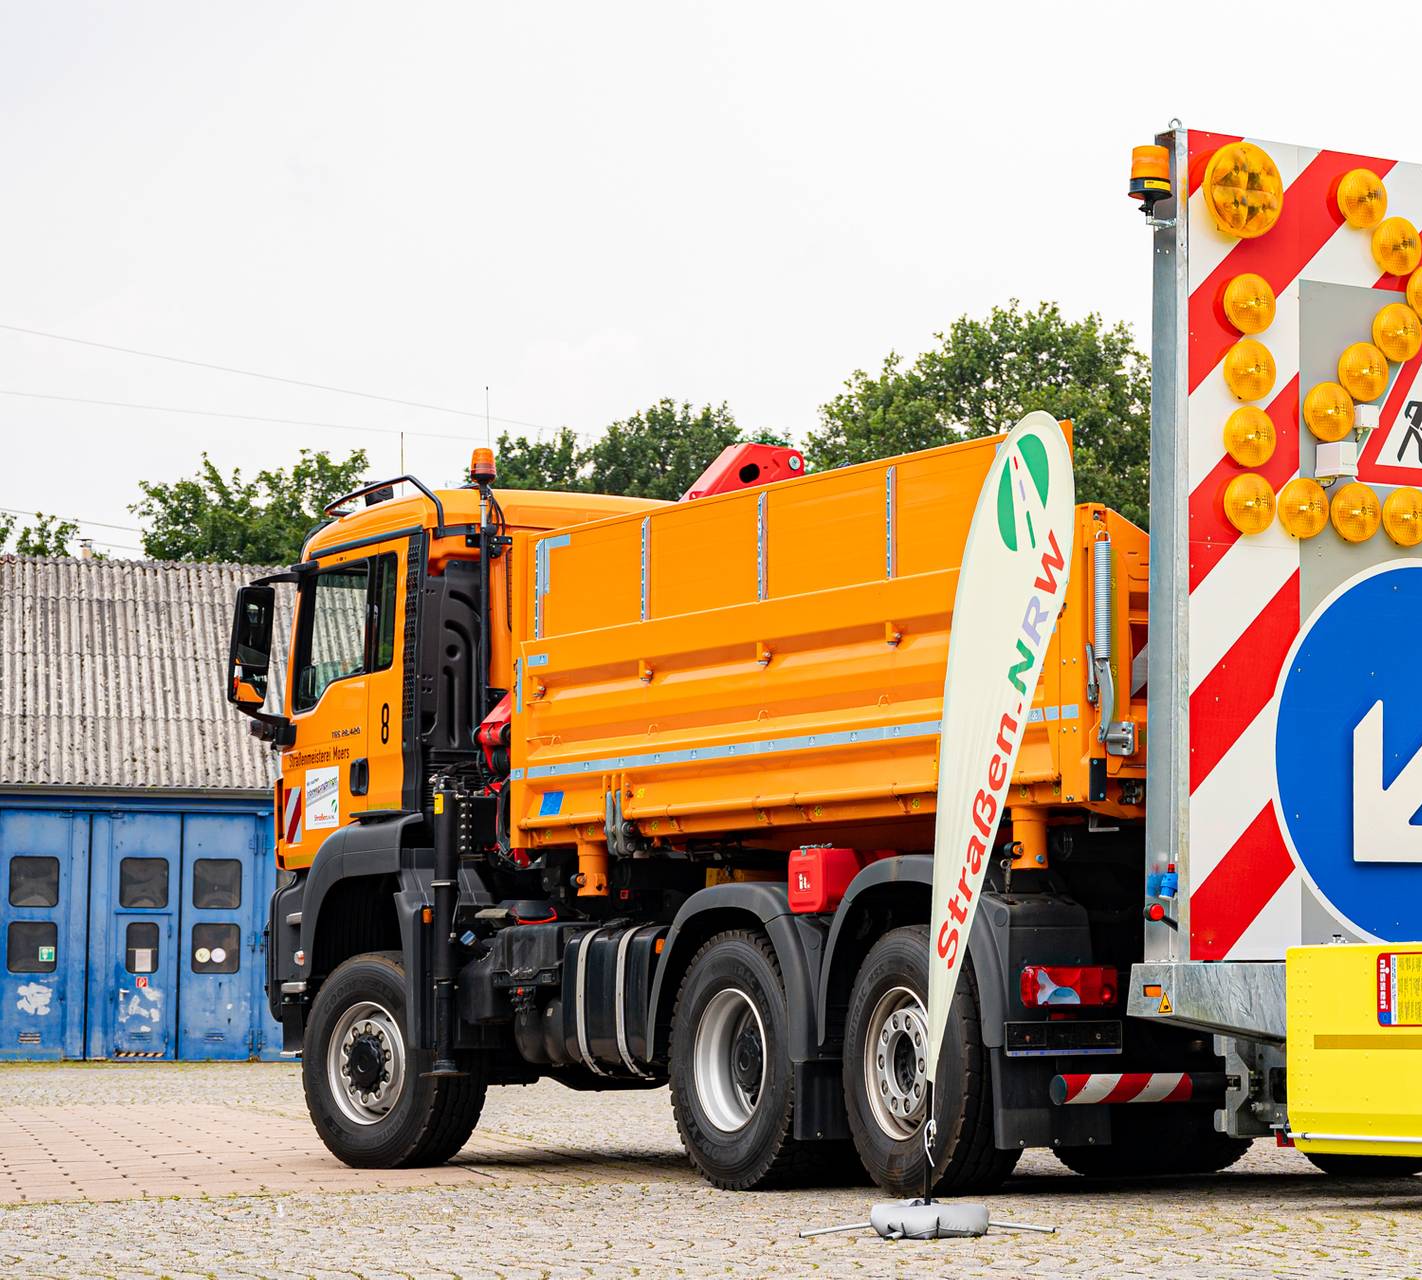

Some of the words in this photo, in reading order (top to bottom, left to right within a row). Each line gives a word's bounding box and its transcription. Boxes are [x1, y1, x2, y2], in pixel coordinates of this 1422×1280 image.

[381, 703, 390, 745] 8
[332, 745, 350, 761] Moers
[937, 528, 1066, 970] Straßen.NRW
[1380, 959, 1390, 1010] nissen
